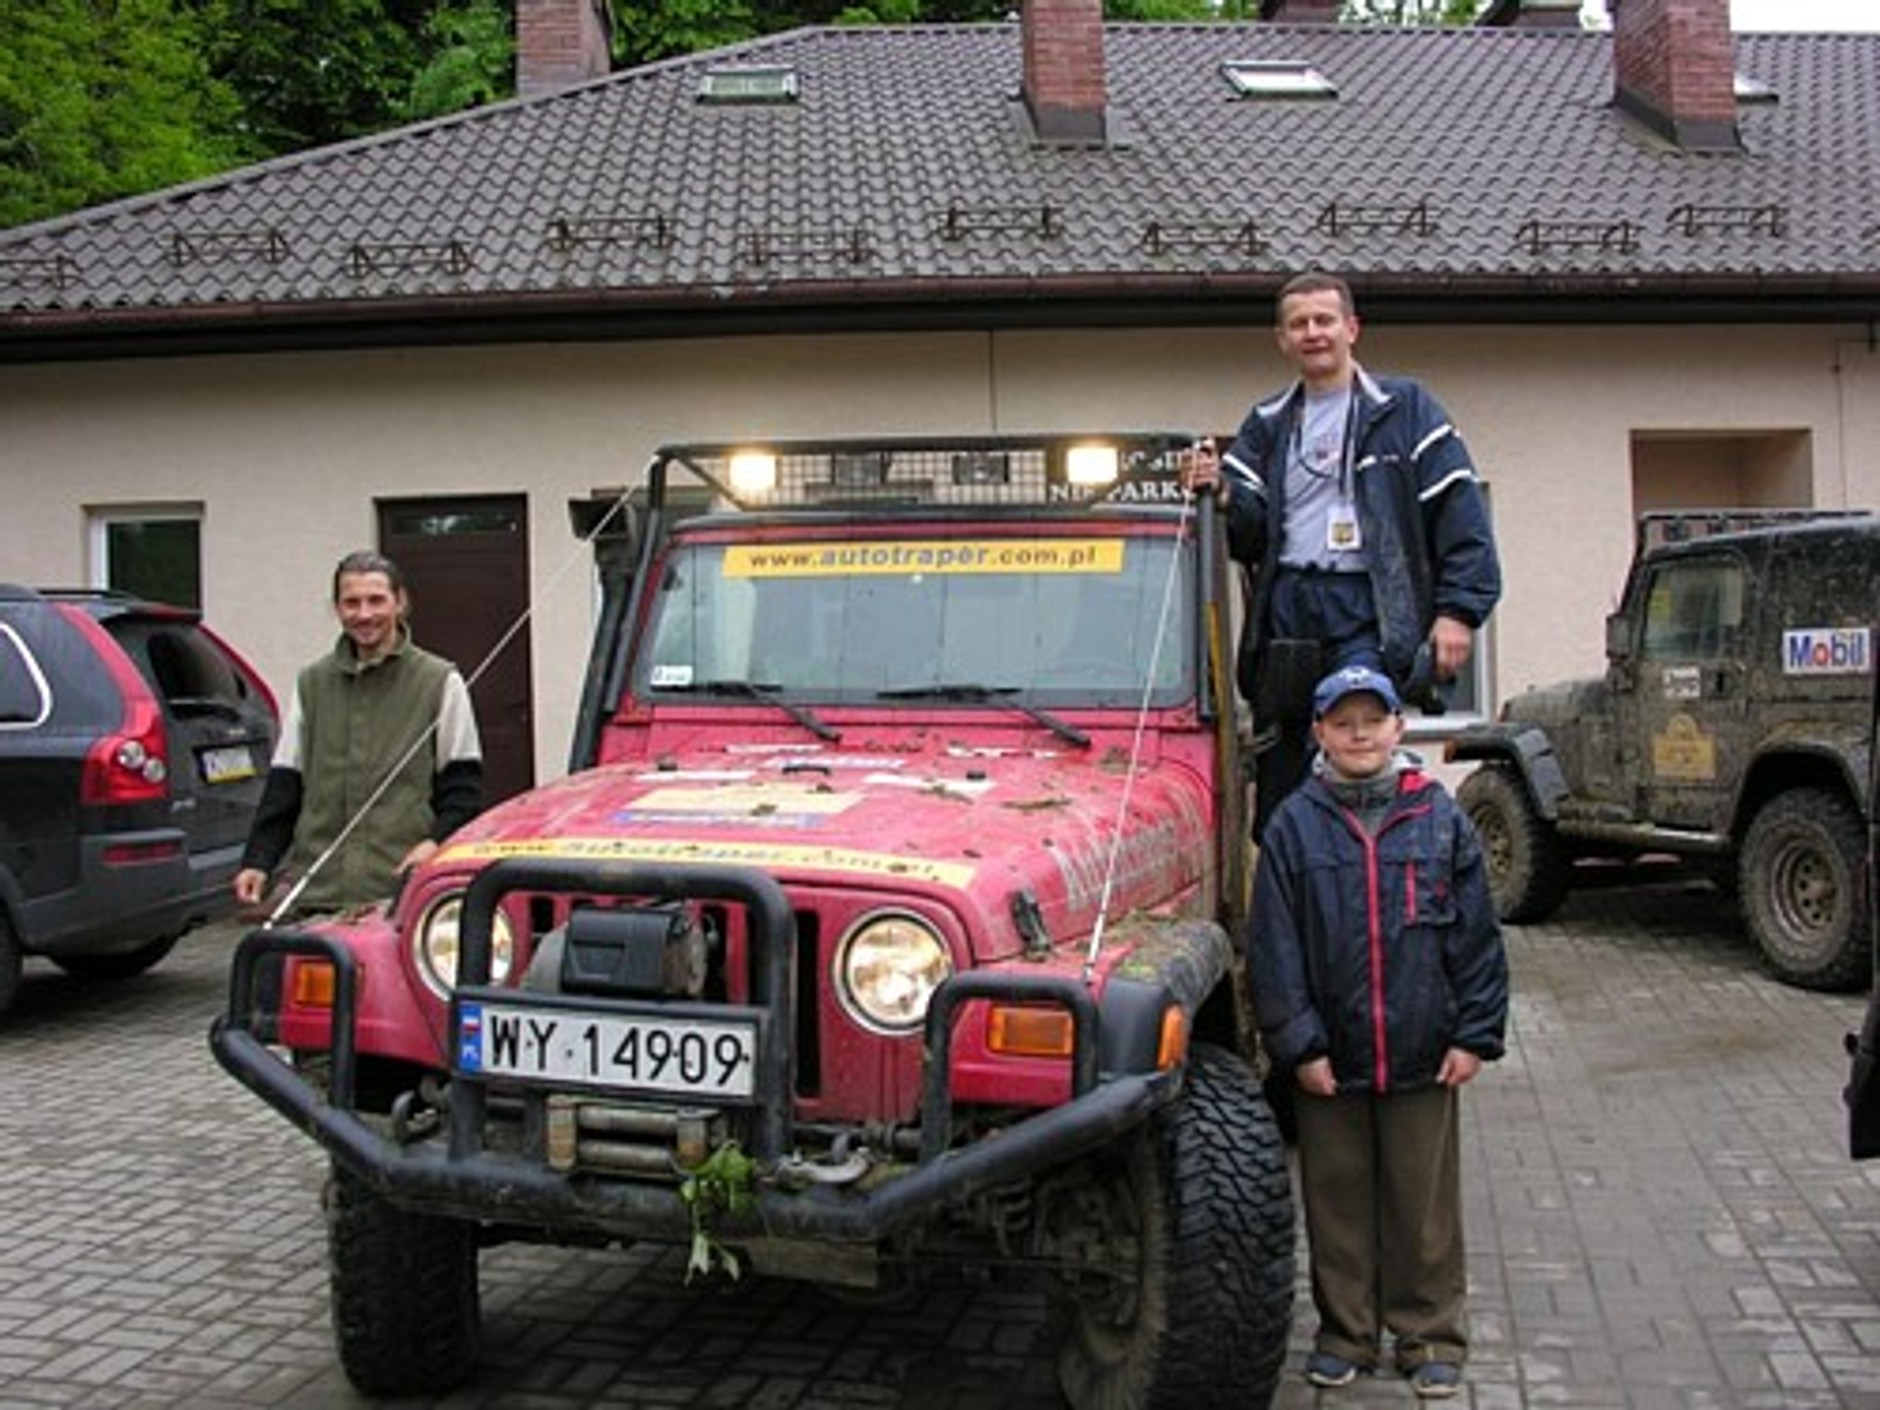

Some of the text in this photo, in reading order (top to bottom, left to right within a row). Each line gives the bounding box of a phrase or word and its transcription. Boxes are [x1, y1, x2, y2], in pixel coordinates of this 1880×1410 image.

[750, 545, 1096, 569] www.autotraper.com.pl
[1788, 632, 1864, 667] Mobil
[582, 1023, 743, 1086] 14909
